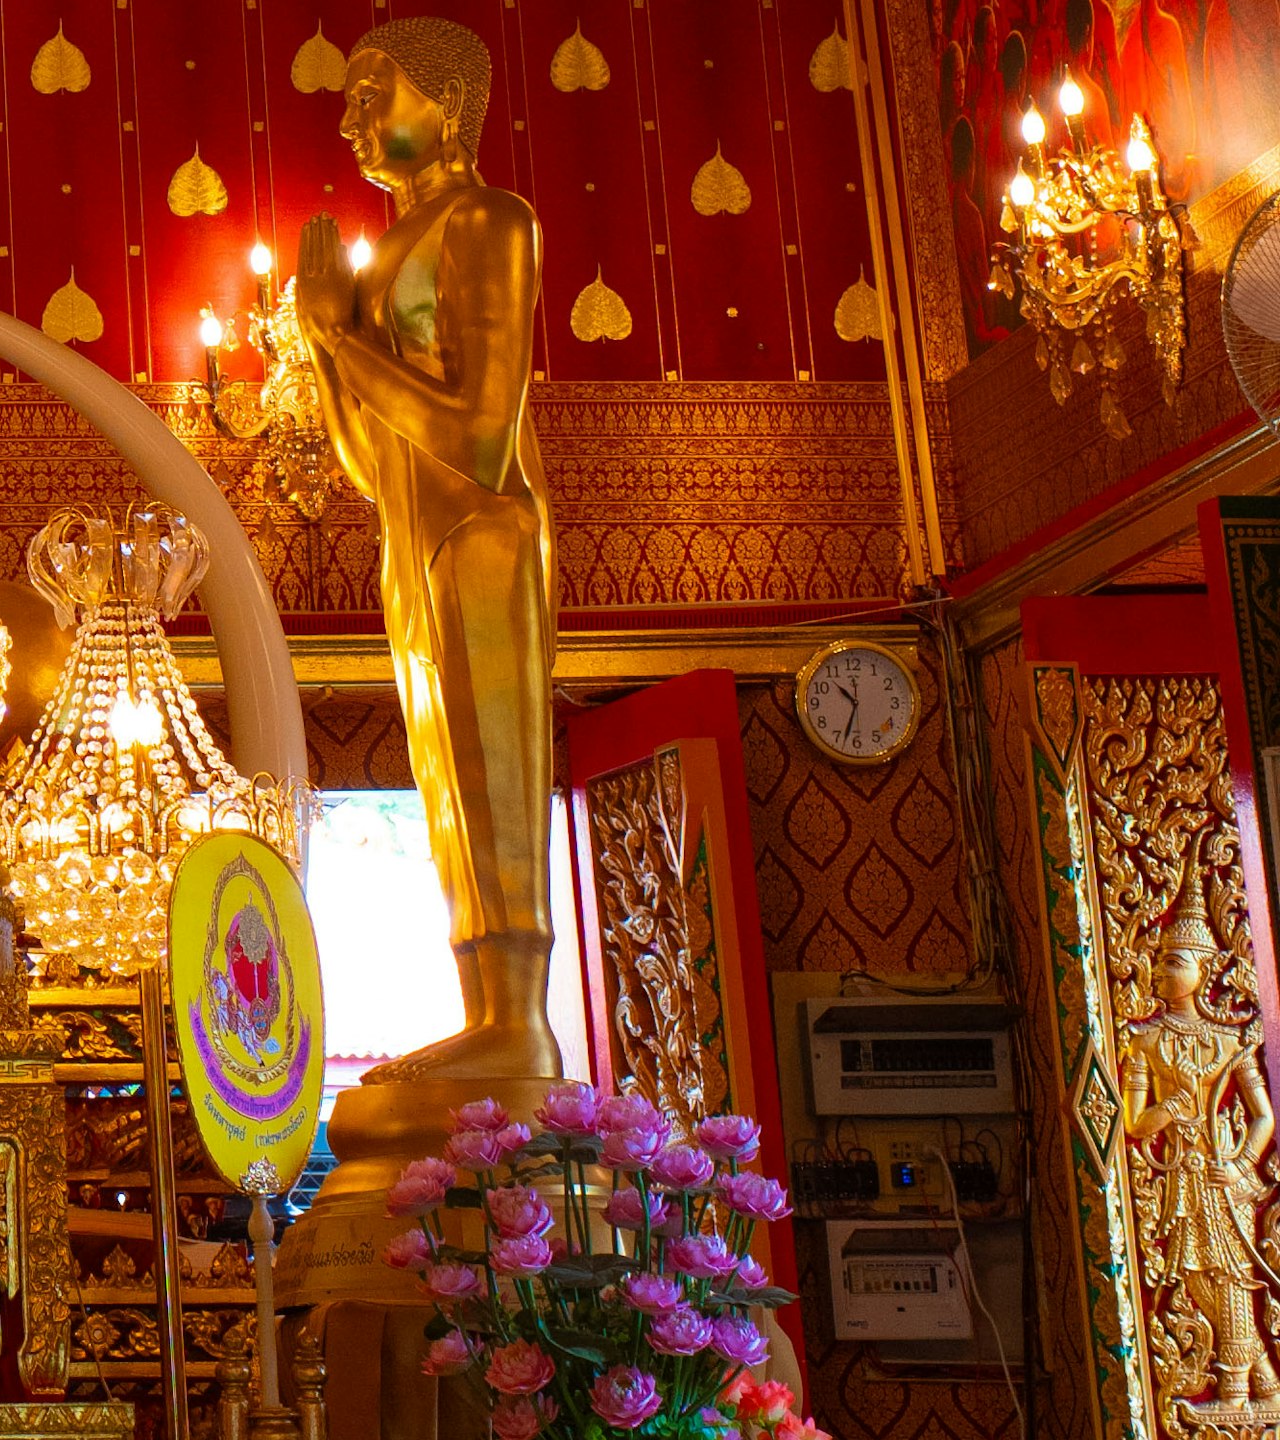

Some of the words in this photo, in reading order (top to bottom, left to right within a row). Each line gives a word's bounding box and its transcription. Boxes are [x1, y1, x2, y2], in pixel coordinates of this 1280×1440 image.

[846, 660, 861, 670] 12
[871, 665, 878, 675] 1
[826, 667, 840, 677] 11
[814, 682, 829, 694] 10
[884, 679, 893, 690] 2
[811, 699, 820, 709] 9
[891, 698, 900, 709] 3
[818, 717, 827, 728] 8
[833, 731, 842, 742] 7
[872, 731, 881, 743] 5
[853, 737, 862, 748] 6
